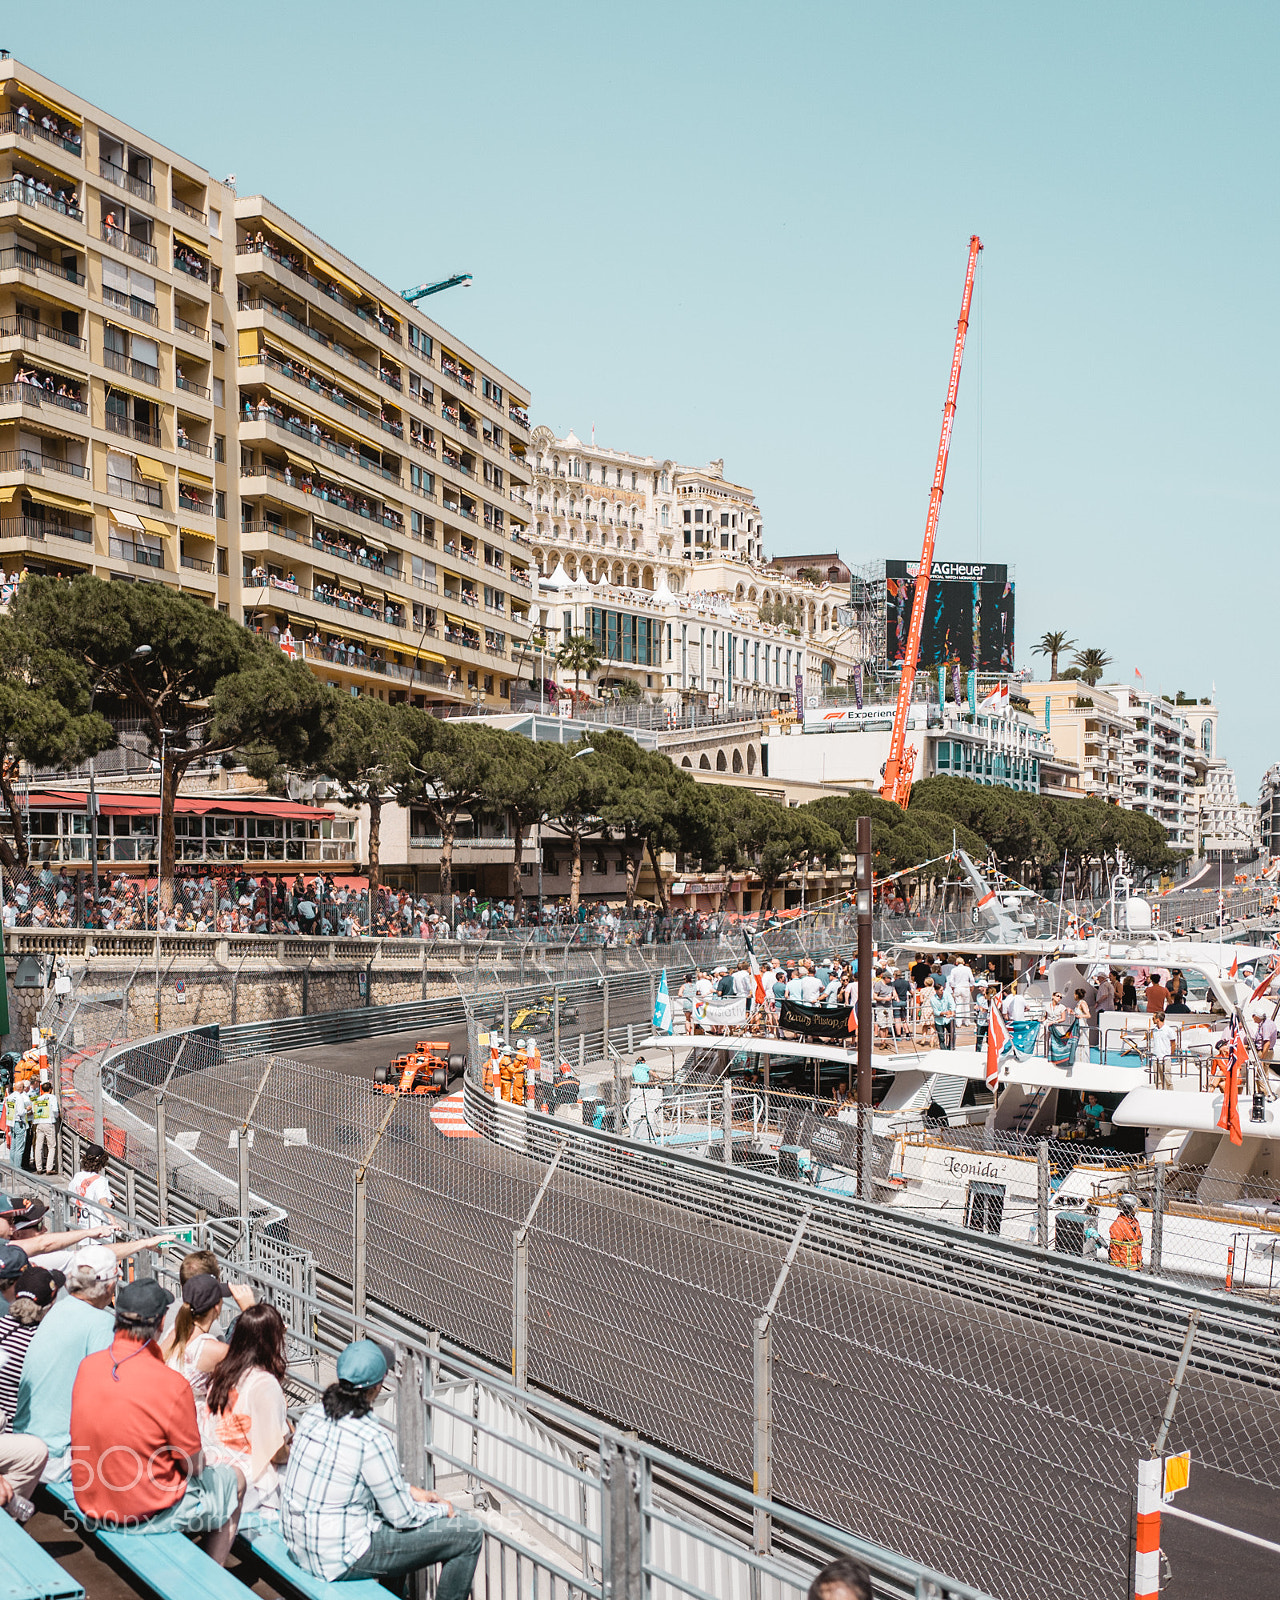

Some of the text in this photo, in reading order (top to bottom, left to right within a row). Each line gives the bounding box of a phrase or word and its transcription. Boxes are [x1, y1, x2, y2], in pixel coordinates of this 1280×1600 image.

[926, 497, 936, 542] IMPERIAL
[911, 586, 922, 632] IMPERIAL
[848, 710, 897, 719] Experienc
[891, 677, 907, 759] IMPERIAL LEVAG
[709, 1005, 745, 1017] visiativ
[785, 1011, 812, 1026] Luxury
[943, 1156, 998, 1180] Leonida
